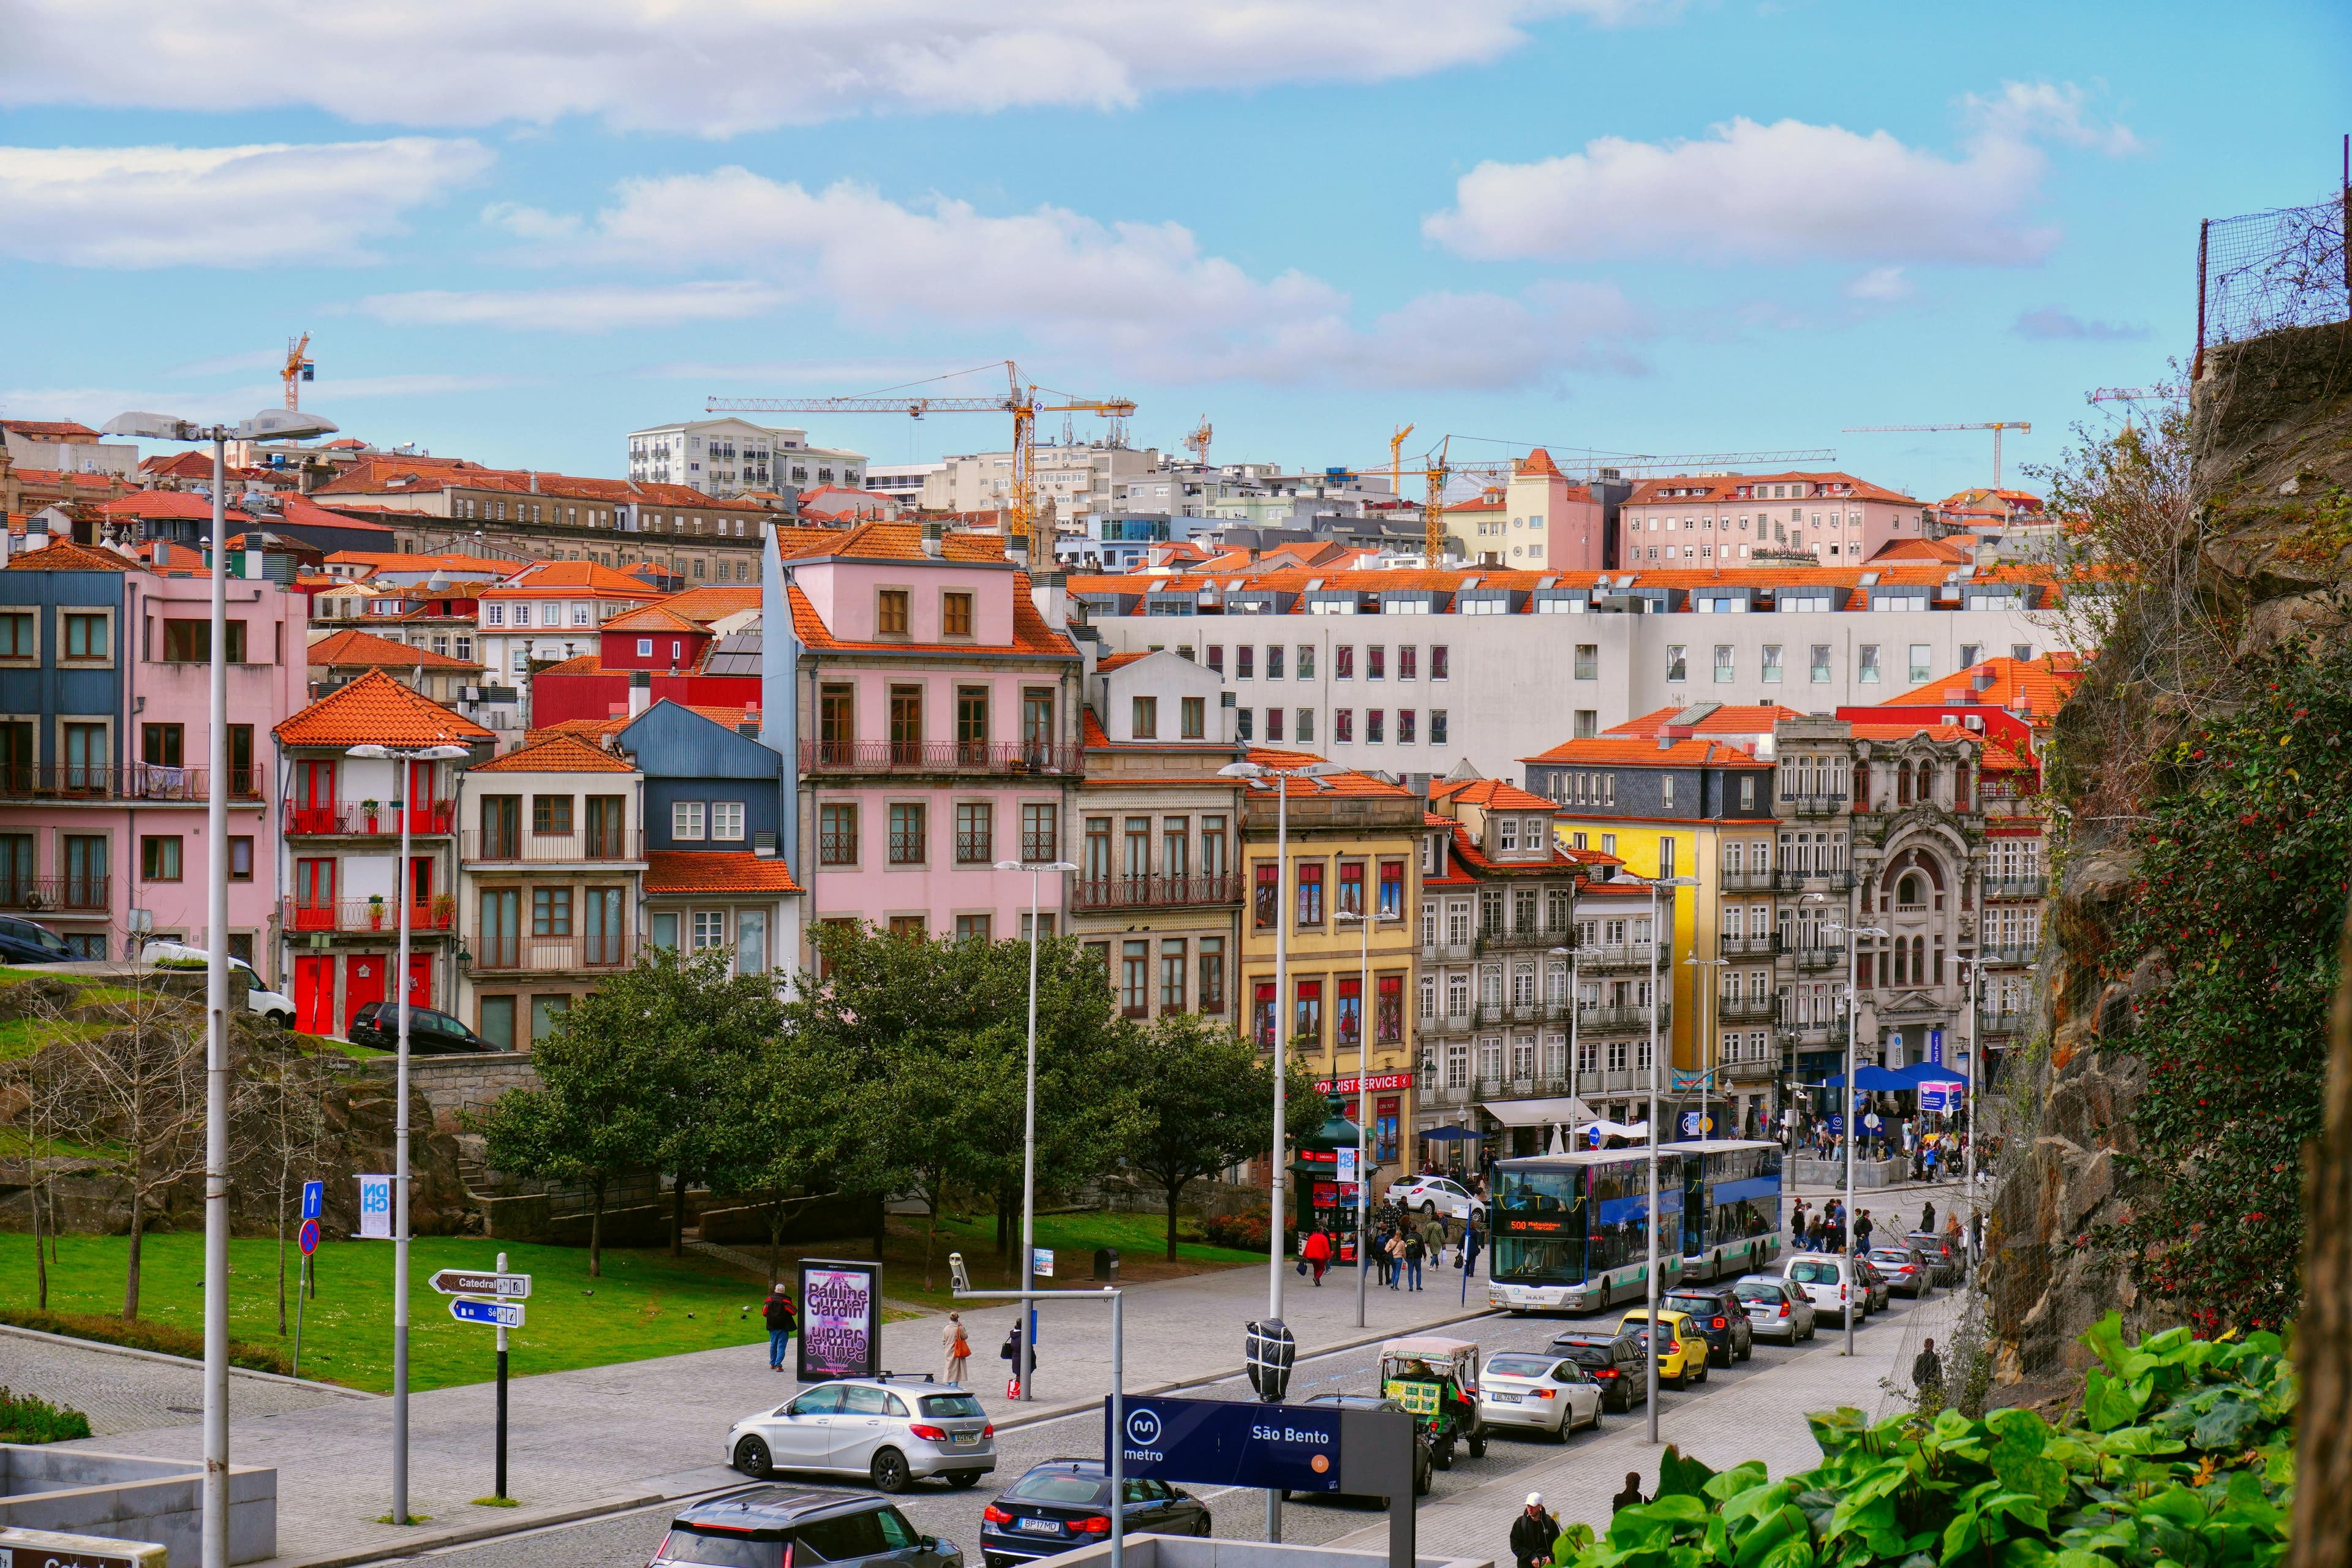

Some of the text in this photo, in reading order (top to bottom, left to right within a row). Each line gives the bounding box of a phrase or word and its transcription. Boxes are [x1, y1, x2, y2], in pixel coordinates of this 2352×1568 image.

[1511, 1221, 1526, 1229] 500
[459, 1278, 497, 1289] Catedral
[809, 1283, 867, 1300] Pauline
[488, 1308, 497, 1317] Sé
[812, 1302, 862, 1318] Jardin
[1253, 1426, 1329, 1444] São Bento
[1124, 1449, 1163, 1462] metro
